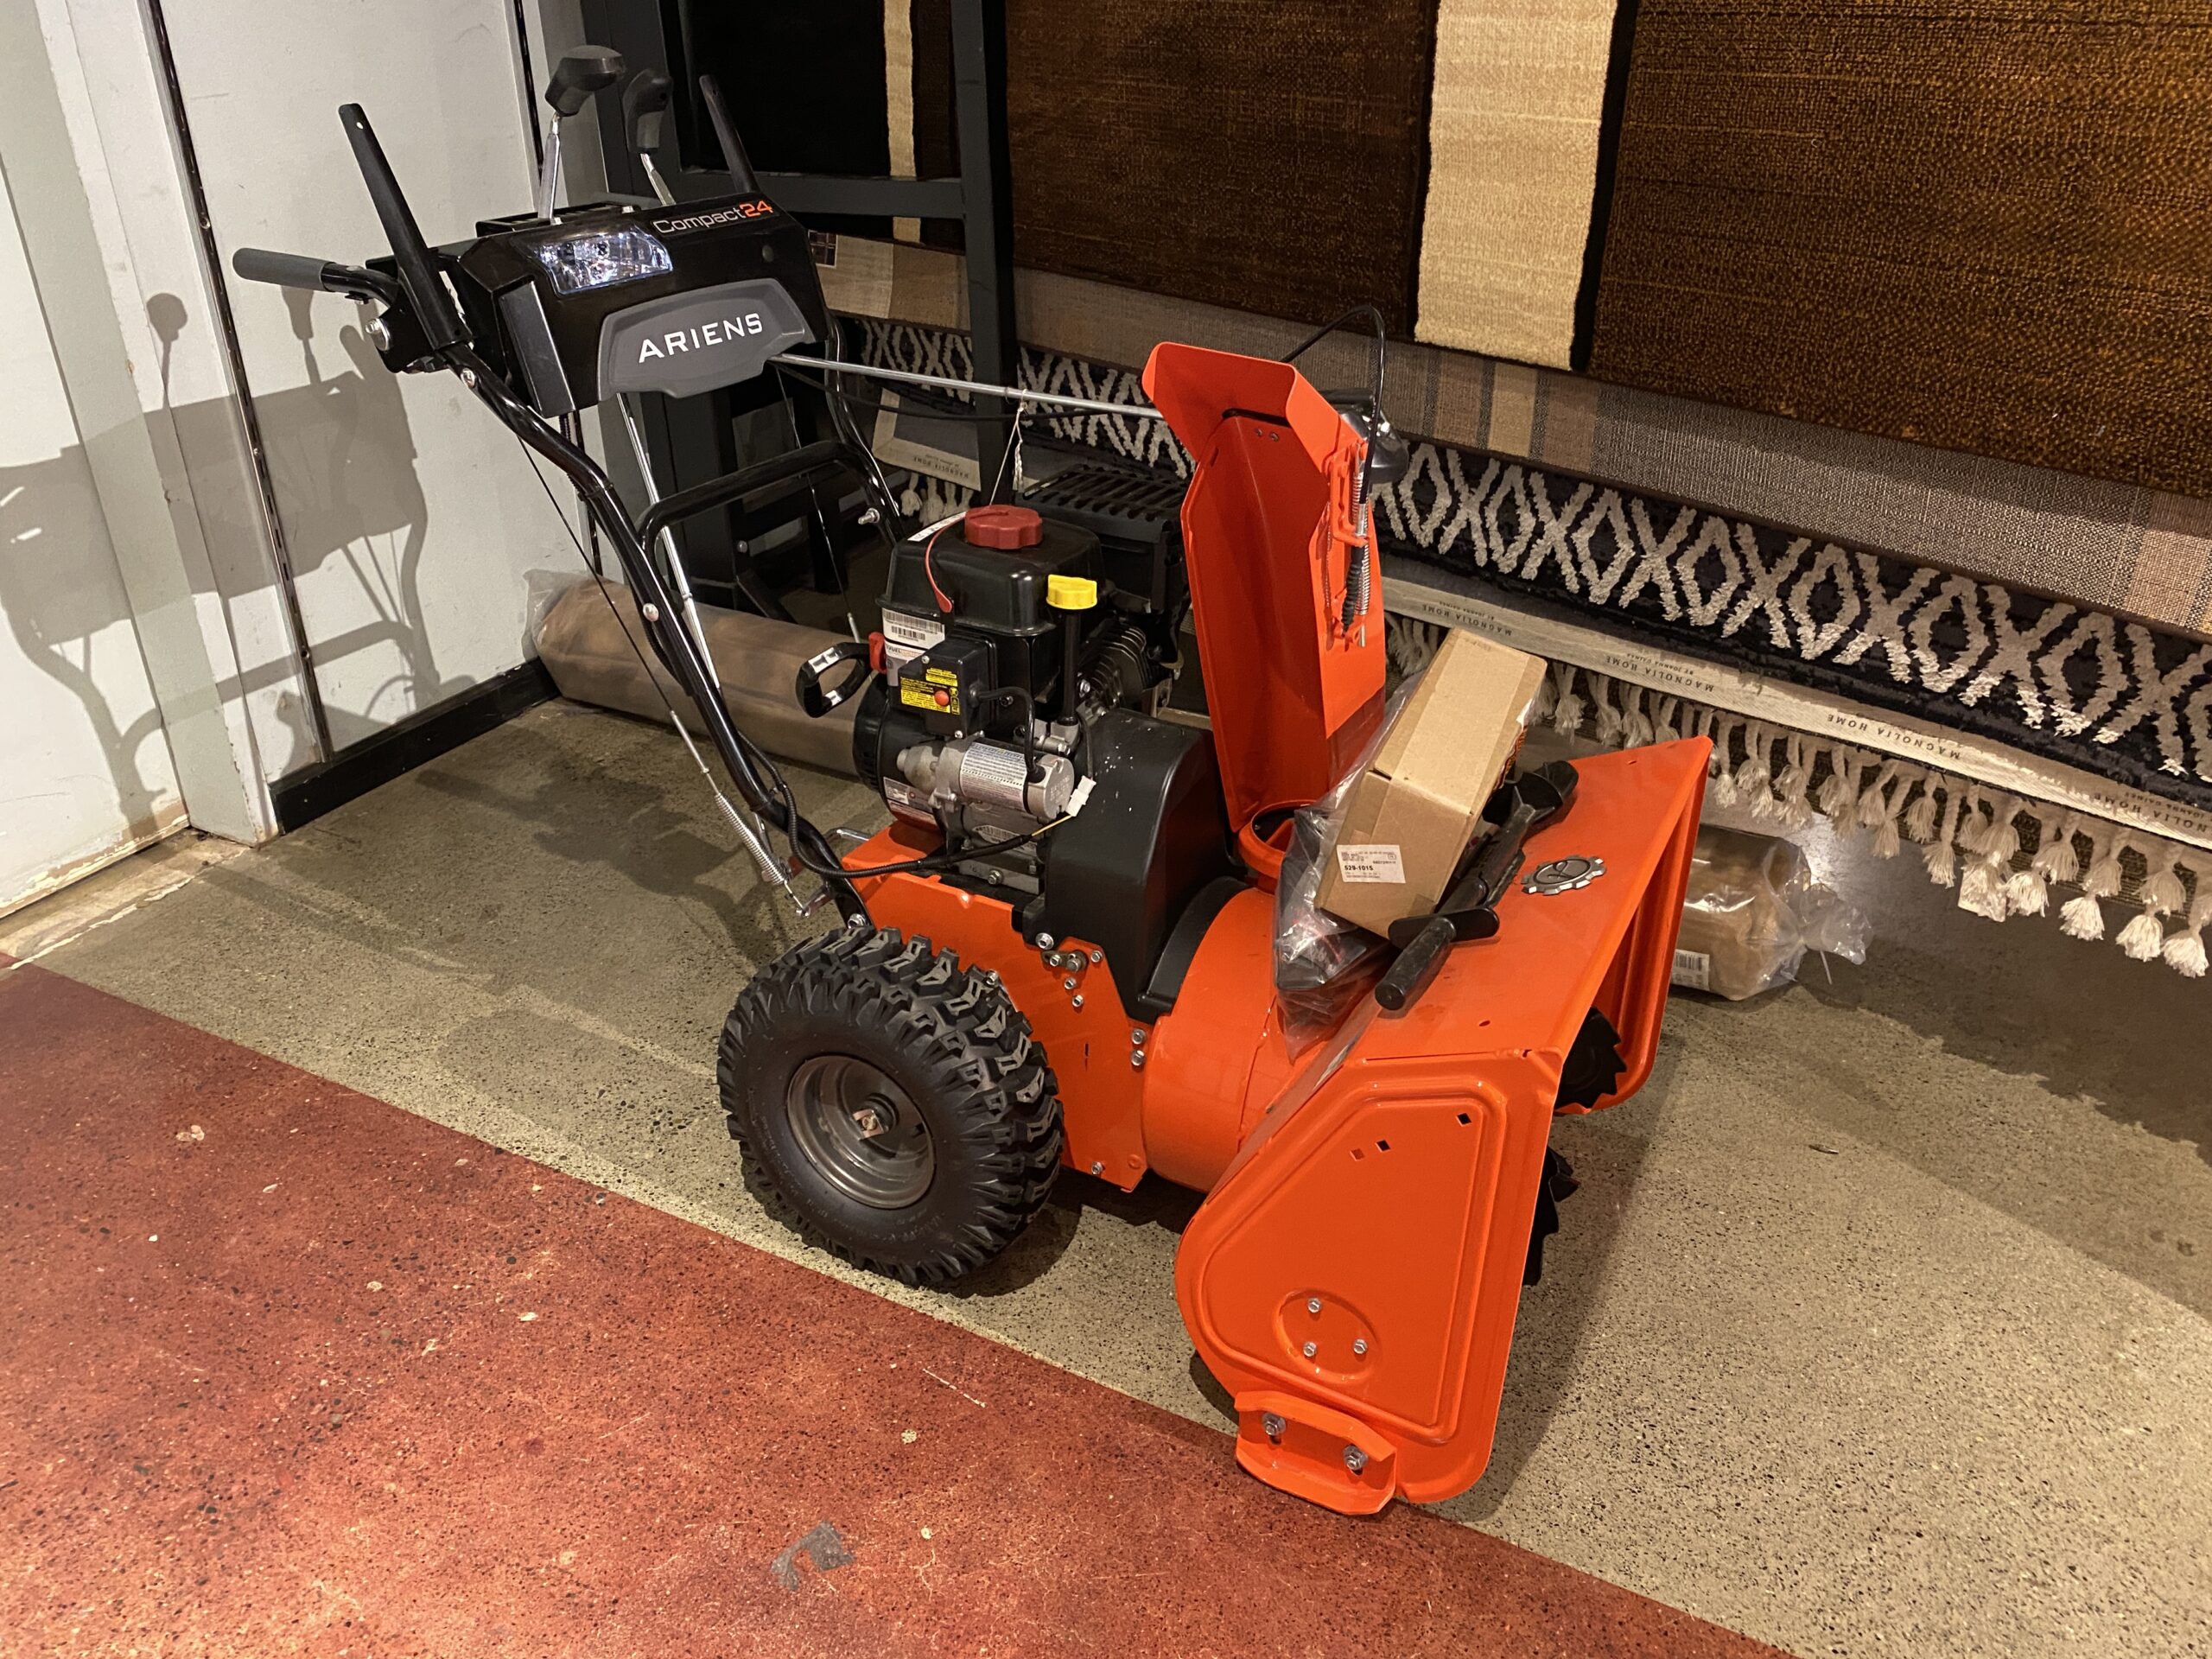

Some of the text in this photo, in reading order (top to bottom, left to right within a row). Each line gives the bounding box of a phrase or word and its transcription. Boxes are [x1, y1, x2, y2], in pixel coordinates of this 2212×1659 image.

[653, 200, 773, 233] Compact24
[639, 312, 763, 364] ARIENS
[1422, 604, 1512, 636] MAGNOLIA HOME
[1606, 656, 1715, 692] MAGNOLIA HOME
[1827, 714, 1868, 732] HOME
[1877, 727, 1961, 760] MAGNOLIA
[2094, 792, 2212, 836] NOLIA HOME
